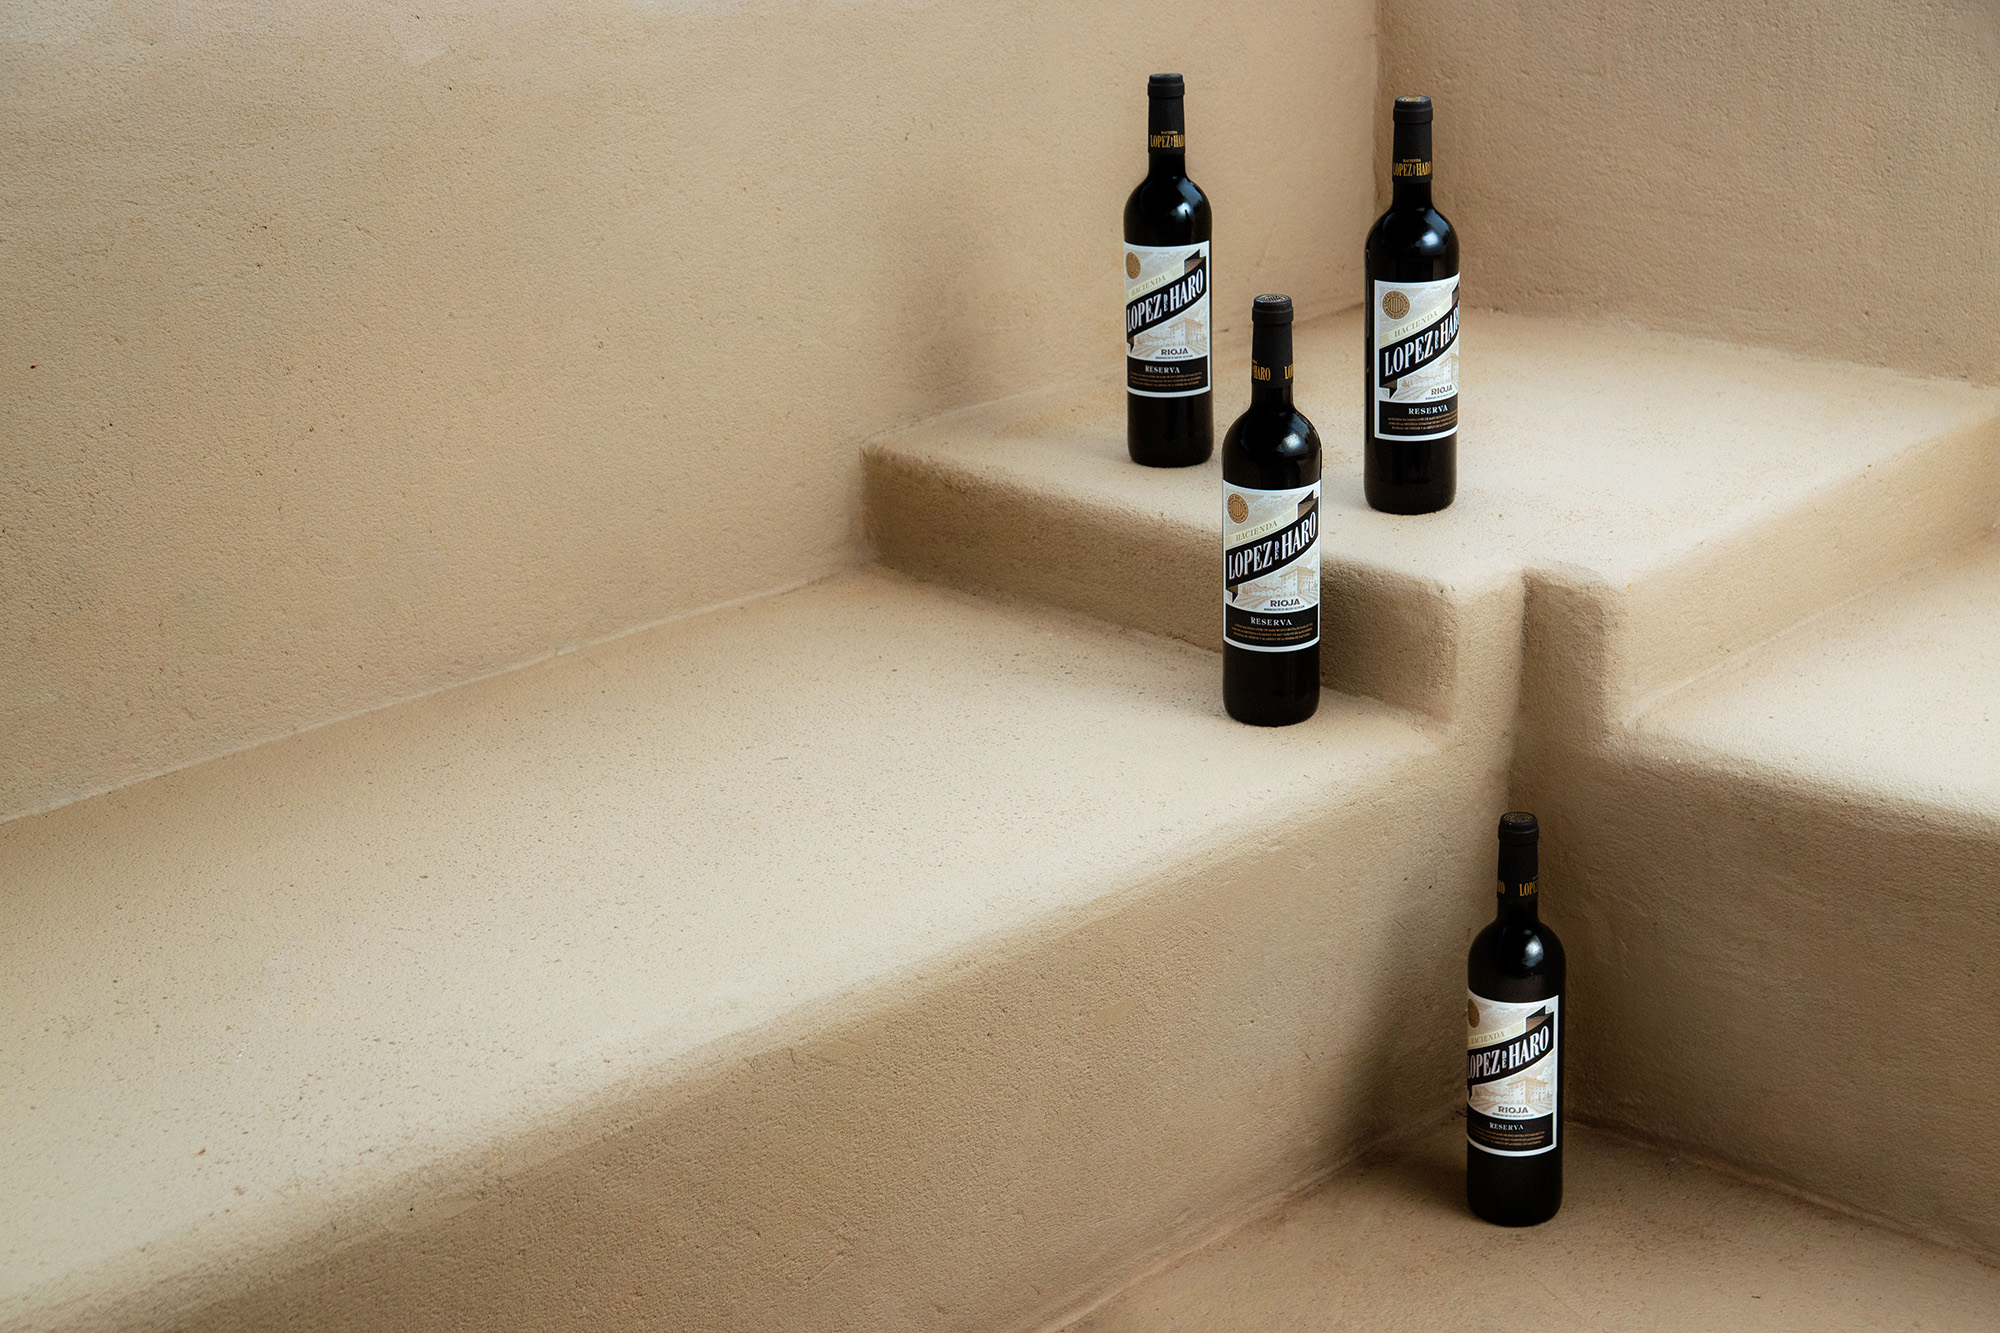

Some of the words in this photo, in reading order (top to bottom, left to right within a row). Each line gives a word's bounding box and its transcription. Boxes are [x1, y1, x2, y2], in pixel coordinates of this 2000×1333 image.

[1150, 134, 1170, 148] LOPEZ
[1392, 162, 1413, 177] LOPEZ
[1127, 293, 1163, 331] LOPEZ
[1169, 268, 1204, 312] HARO
[1394, 310, 1438, 338] HACIENDA
[1384, 330, 1434, 377] LOPEZ
[1440, 299, 1459, 349] HAR
[1161, 347, 1189, 356] RIOJA
[1145, 364, 1181, 374] RESERVA
[1431, 384, 1453, 396] RIOJA
[1408, 404, 1449, 415] RESERVA
[1235, 520, 1278, 542] HACIENDA
[1228, 540, 1273, 580] LOPEZ
[1281, 511, 1317, 560] HARO
[1270, 598, 1301, 607] RIOJA
[1250, 616, 1293, 626] RESERVA
[1508, 1025, 1550, 1070] HARO
[1498, 1105, 1529, 1114] RIOJA
[1489, 1122, 1524, 1131] RESERVA
